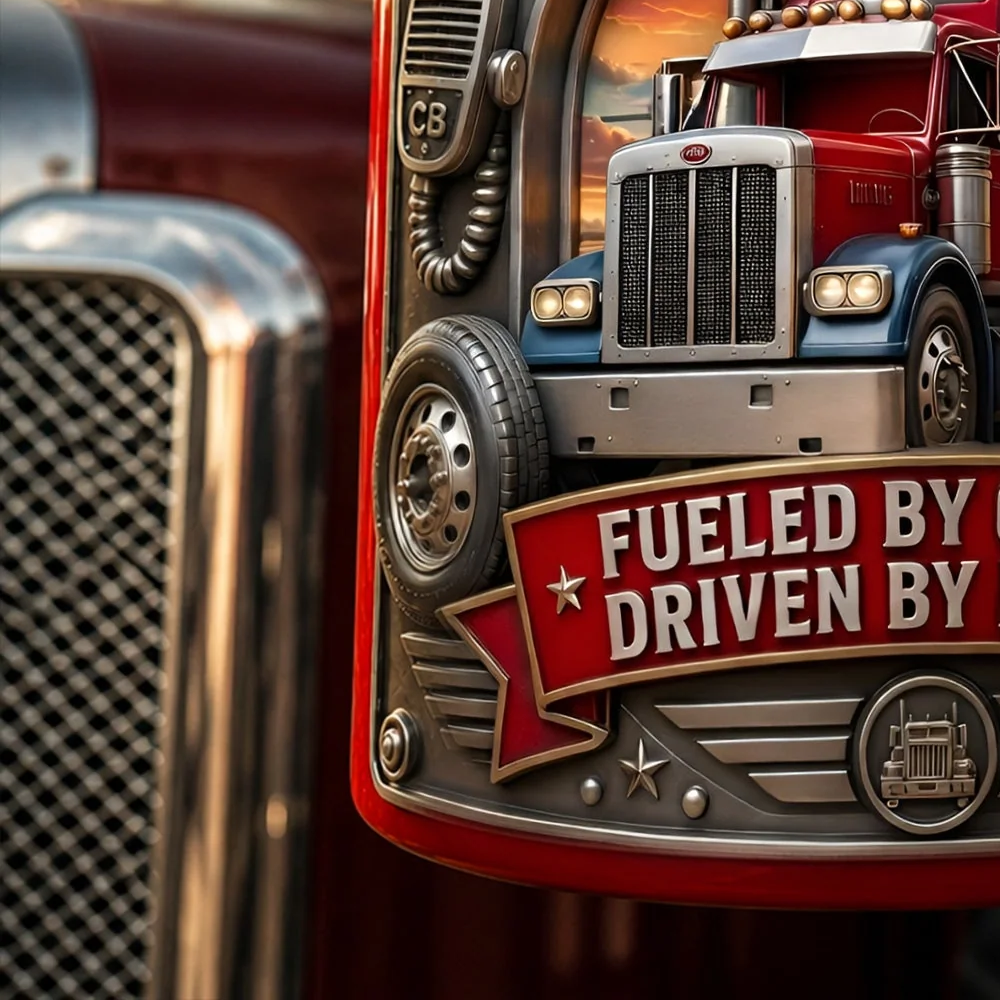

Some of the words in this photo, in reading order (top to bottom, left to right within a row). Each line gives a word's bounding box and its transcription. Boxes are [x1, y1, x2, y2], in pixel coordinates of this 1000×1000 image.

[408, 101, 447, 138] CB
[597, 483, 856, 579] FUELED
[884, 479, 976, 547] BY
[607, 564, 863, 661] DRIVEN
[888, 560, 979, 630] BY
